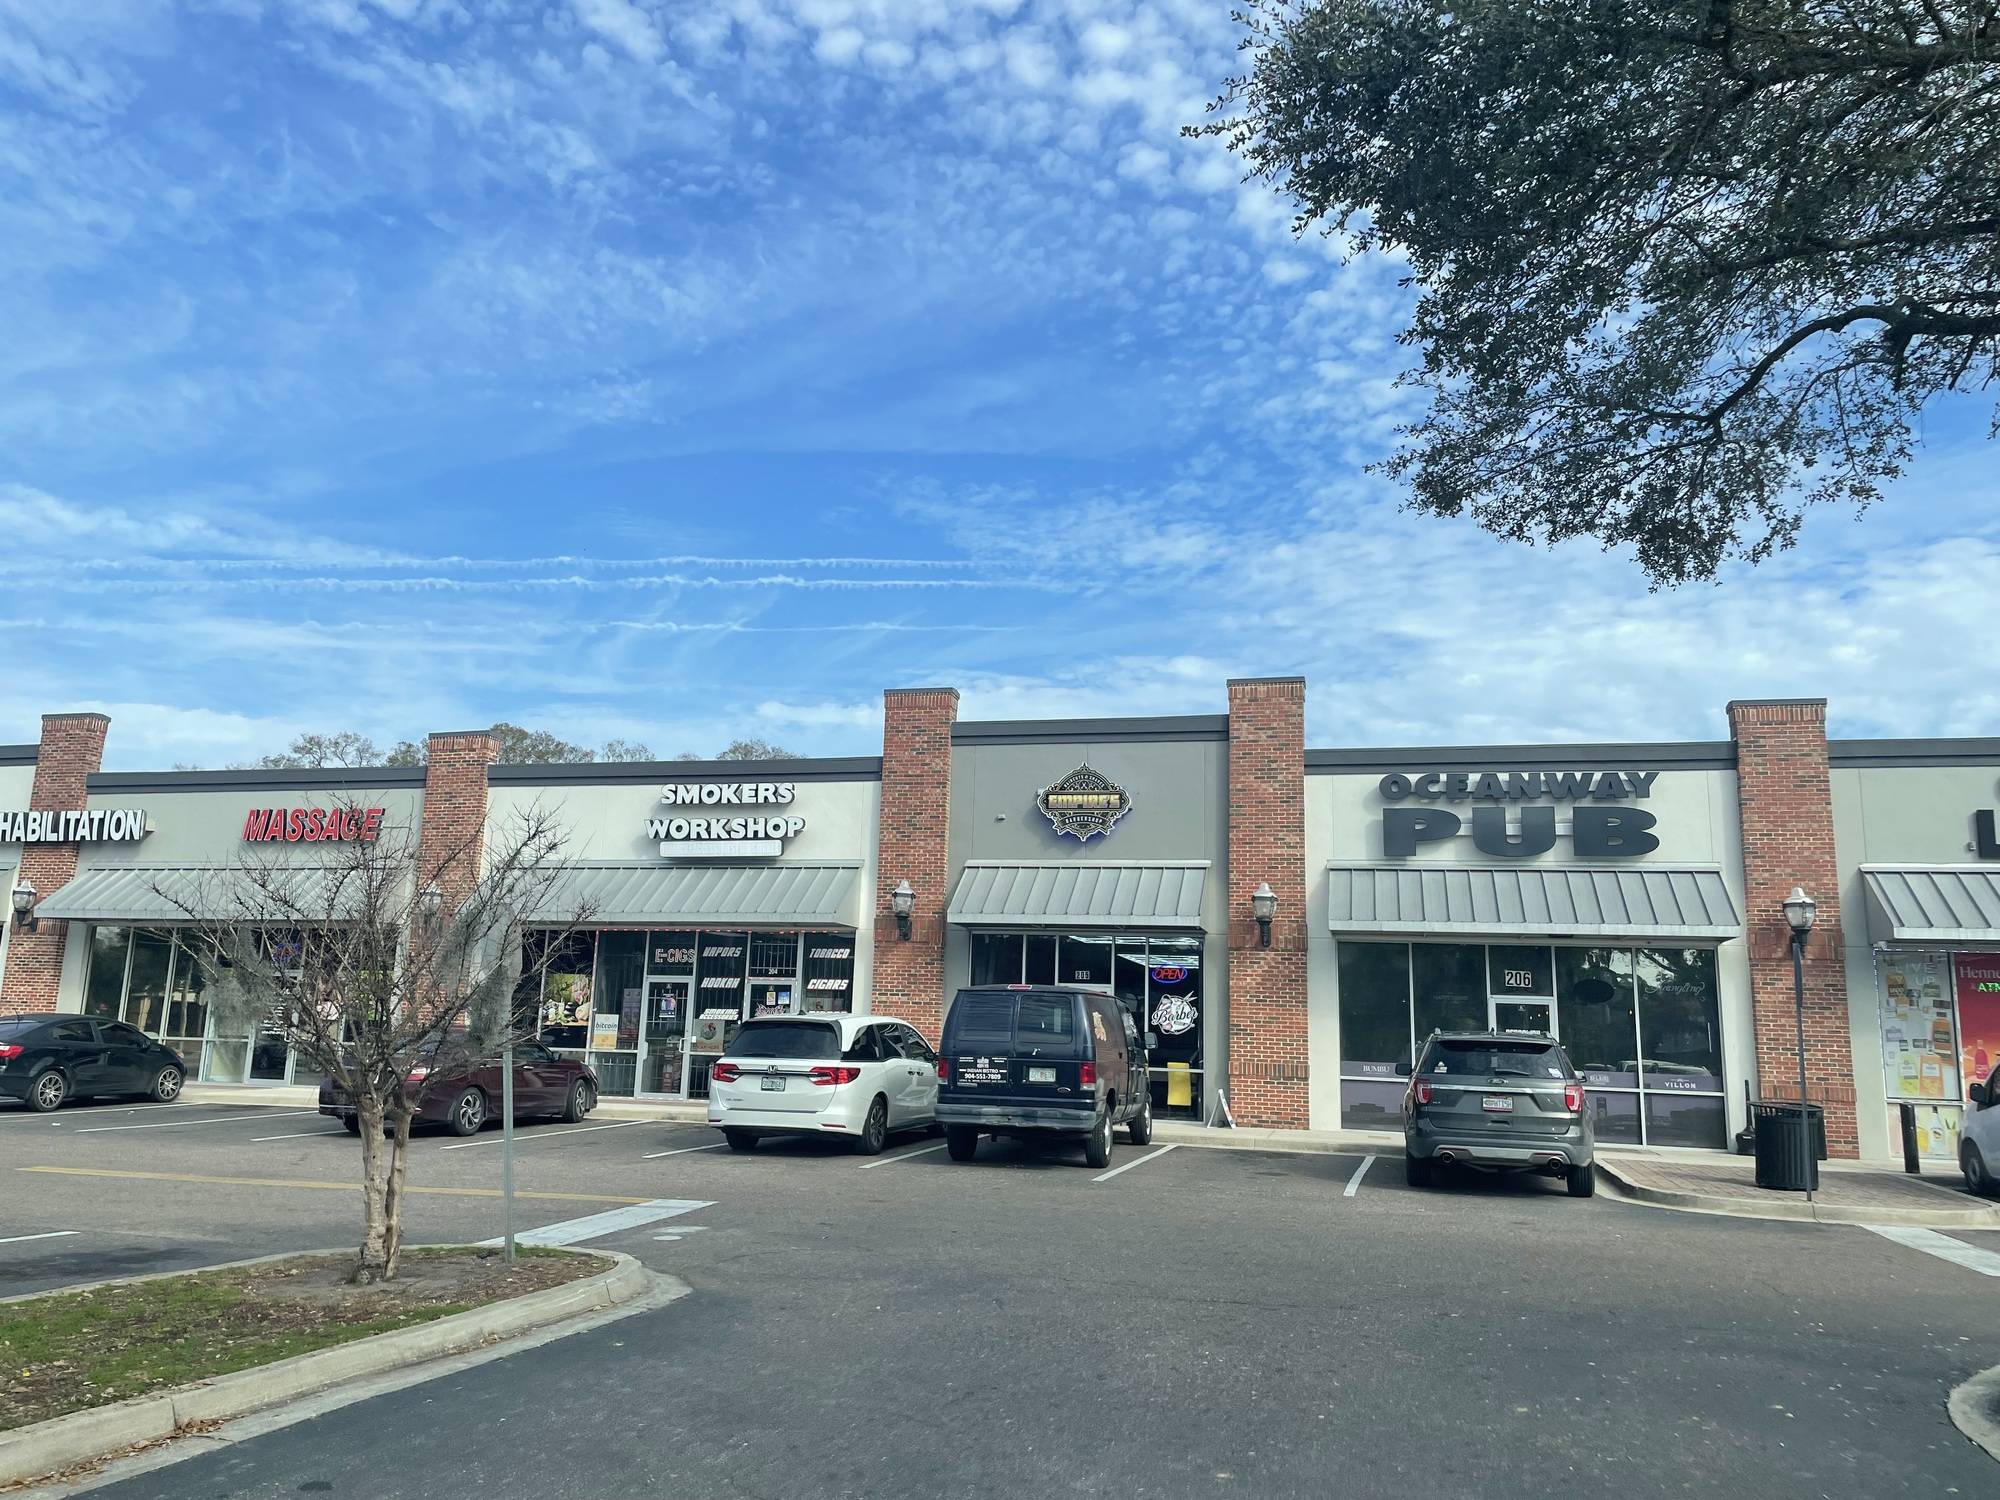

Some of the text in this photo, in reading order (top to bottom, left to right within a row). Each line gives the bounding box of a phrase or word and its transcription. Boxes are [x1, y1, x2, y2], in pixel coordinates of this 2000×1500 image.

[1378, 772, 1659, 800] OCEANWAY
[661, 783, 795, 805] SMOKERS
[0, 809, 143, 842] HABILITATION
[242, 807, 386, 842] MASSAGE
[644, 816, 806, 840] WORKSHOP
[1383, 806, 1660, 857] PUB
[655, 948, 696, 963] E-CIGS
[702, 946, 742, 958] VAPORS
[809, 948, 850, 959] TOBACCO
[1075, 970, 1091, 980] 205
[1154, 967, 1185, 980] OPEN
[1505, 970, 1532, 987] 206
[700, 977, 741, 989] HOOKAH
[807, 979, 849, 990] CIGARS
[1151, 1003, 1198, 1024] Barber
[595, 1021, 618, 1030] bitcoin
[1664, 1081, 1697, 1089] VILLON
